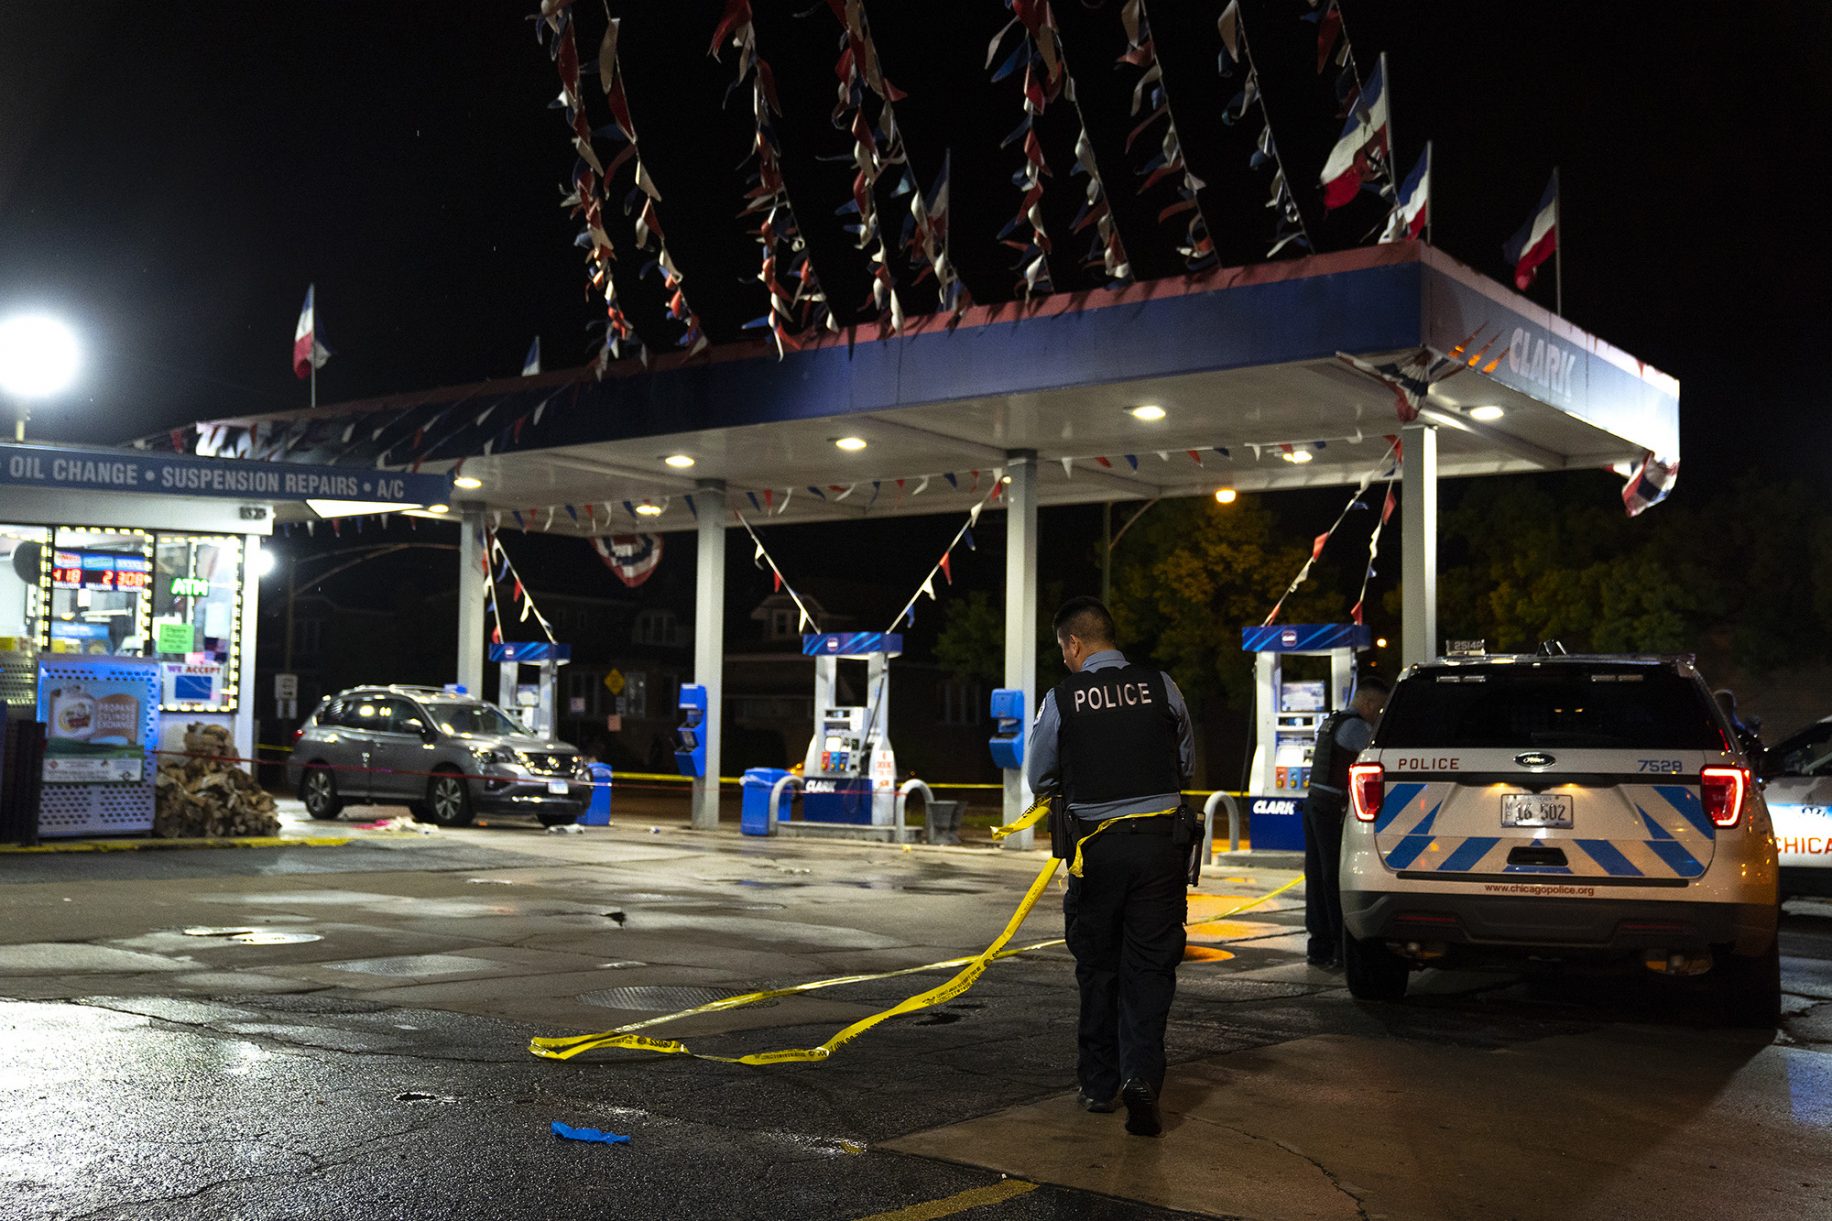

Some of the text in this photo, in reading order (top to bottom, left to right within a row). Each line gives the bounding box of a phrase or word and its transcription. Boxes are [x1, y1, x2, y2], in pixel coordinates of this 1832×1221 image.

[1508, 327, 1576, 402] CLARK
[9, 455, 404, 500] OIL CHANGE SUSPENSION REPAIRS A/C
[171, 578, 209, 596] ATM
[186, 666, 221, 674] ACCEPT
[1073, 682, 1152, 713] POLICE
[1398, 758, 1460, 770] POLICE
[1637, 760, 1683, 773] 7528
[805, 780, 837, 793] CLARK
[1253, 800, 1295, 815] CLARK
[1516, 803, 1566, 821] 16 502
[1484, 884, 1595, 896] www.chicagopolice.org
